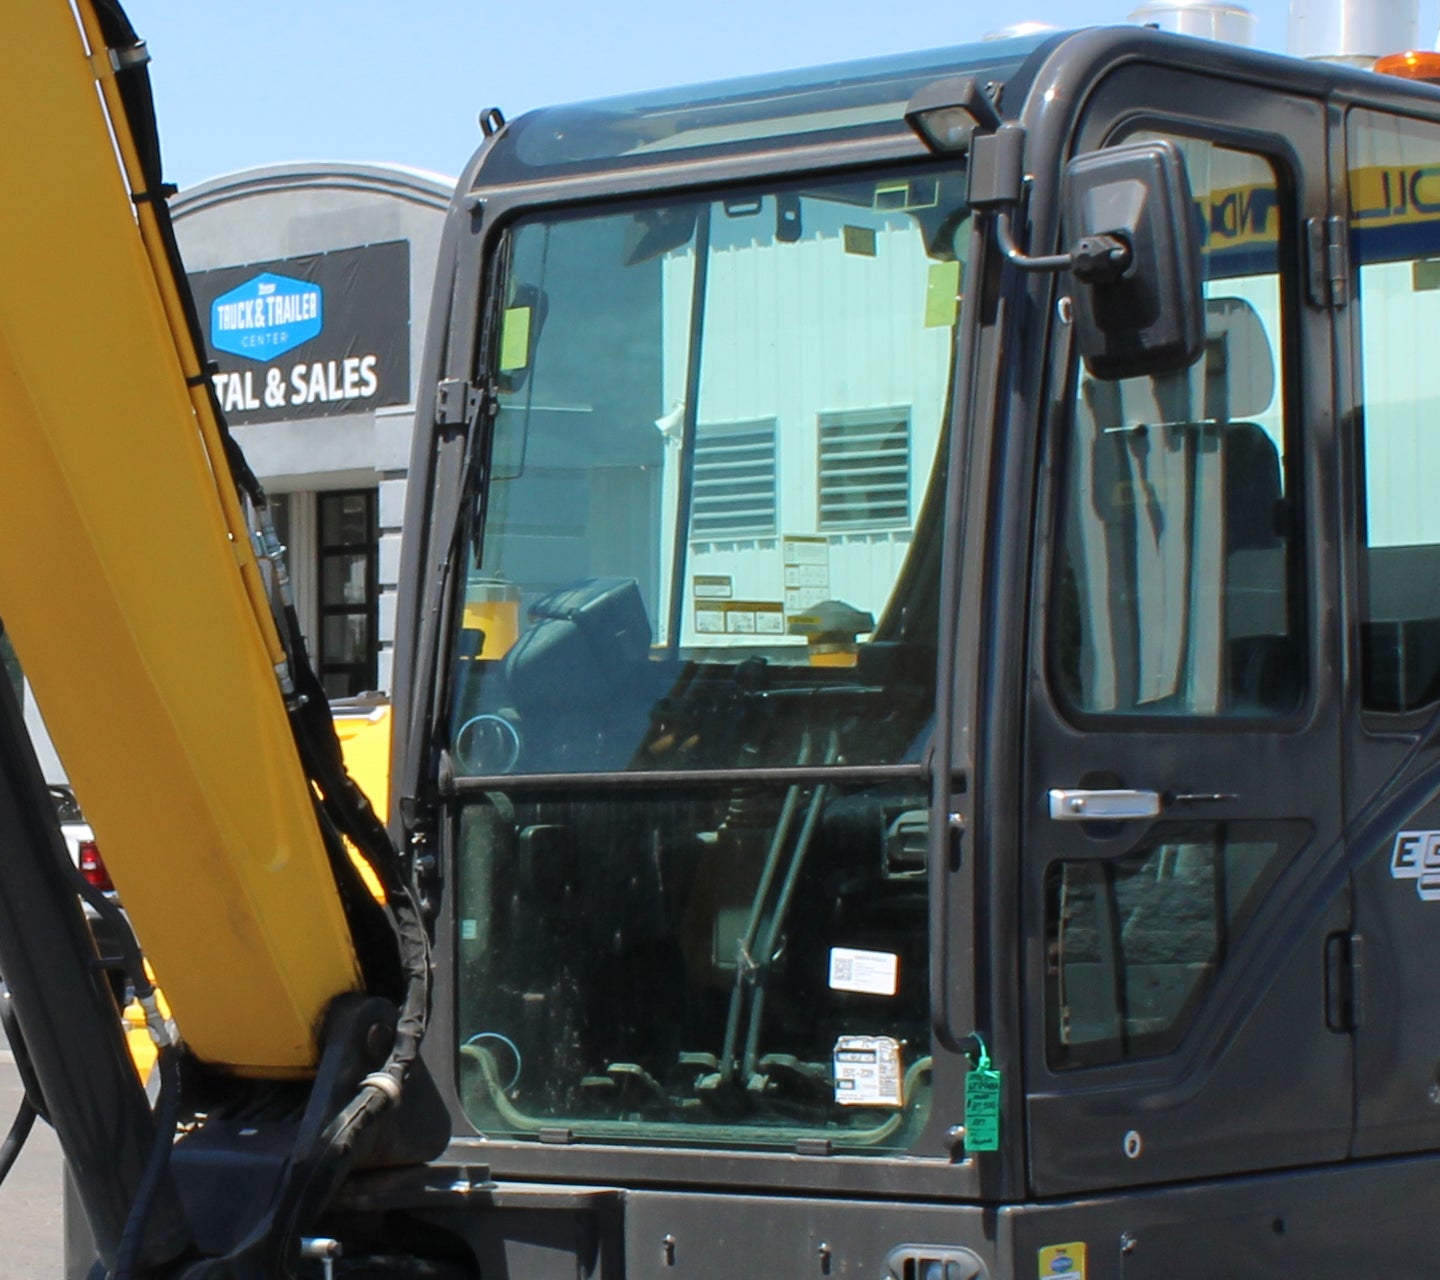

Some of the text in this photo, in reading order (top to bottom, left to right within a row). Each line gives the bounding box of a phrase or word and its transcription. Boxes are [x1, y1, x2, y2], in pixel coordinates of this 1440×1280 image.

[218, 300, 253, 330] TRUCK
[267, 293, 316, 326] TRAILER
[242, 332, 287, 347] CENTER
[212, 355, 378, 412] TAL & SALES
